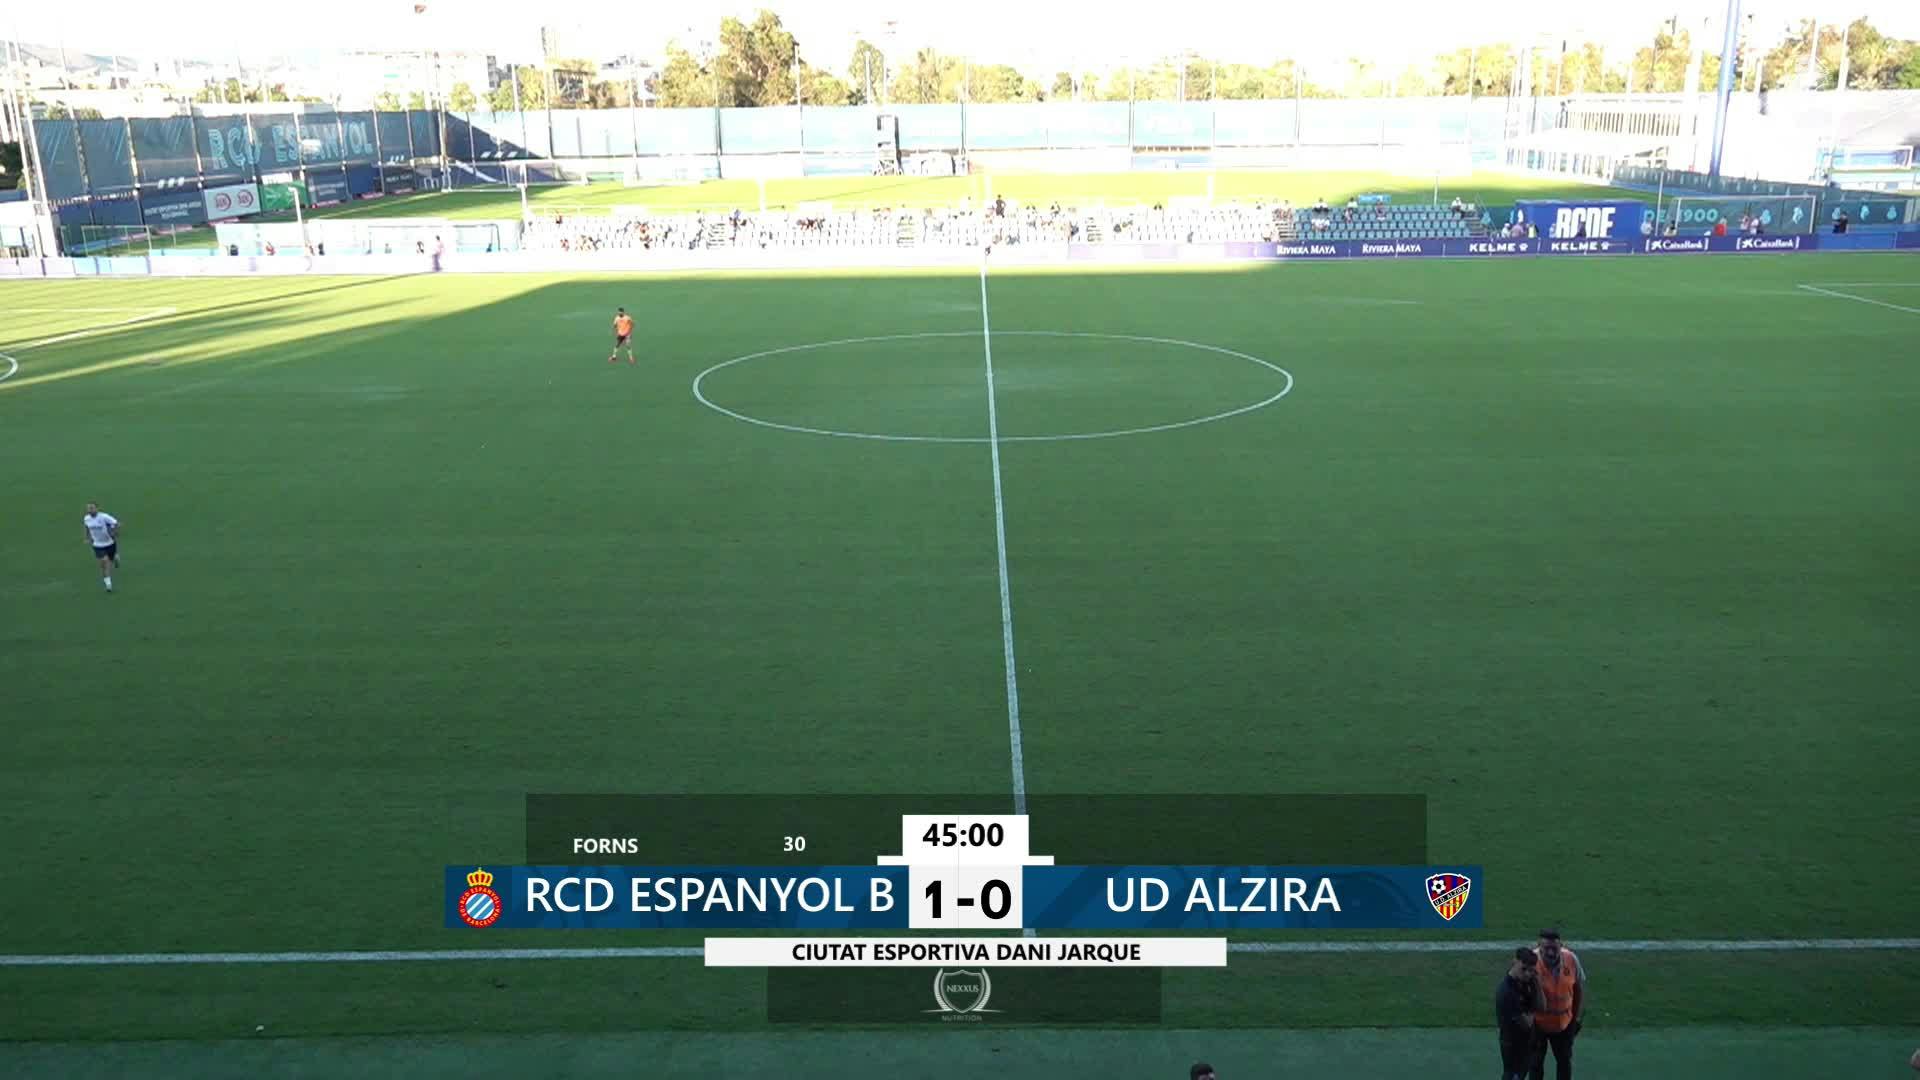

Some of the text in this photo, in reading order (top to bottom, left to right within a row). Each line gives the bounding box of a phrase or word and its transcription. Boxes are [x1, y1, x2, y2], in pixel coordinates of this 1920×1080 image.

[207, 126, 261, 168] RCD
[1555, 207, 1616, 238] RCDE
[1469, 243, 1517, 253] KELME
[1551, 241, 1598, 251] KELME
[1663, 239, 1703, 250] CaixaBank
[1753, 238, 1794, 249] CaixaBank
